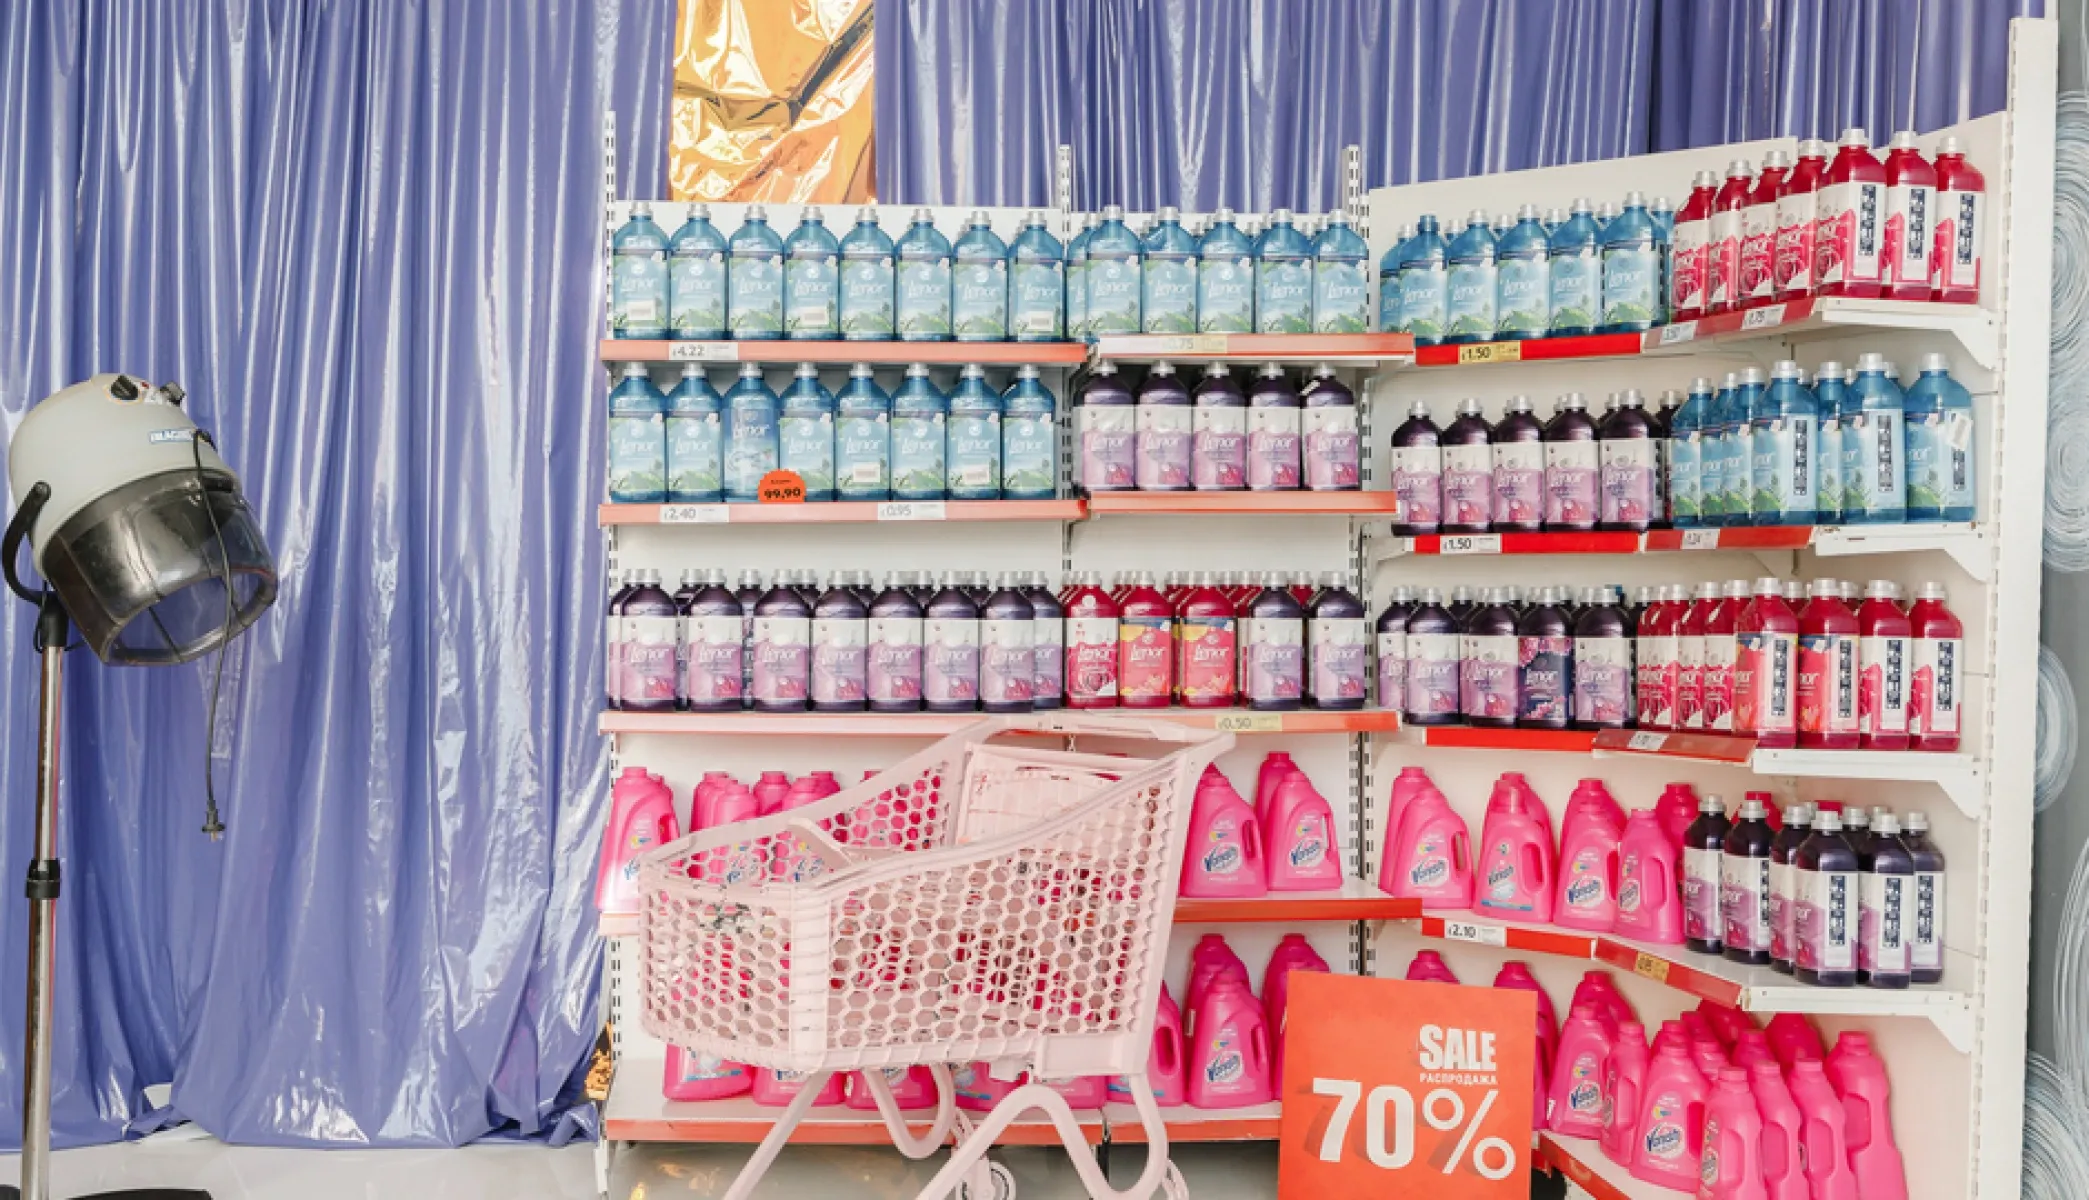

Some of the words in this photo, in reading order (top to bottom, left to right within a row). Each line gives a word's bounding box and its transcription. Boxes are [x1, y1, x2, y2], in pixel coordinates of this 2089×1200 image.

[1420, 1024, 1496, 1071] SALE
[1420, 1073, 1497, 1085] РАСПРОДАЖА
[1312, 1077, 1516, 1181] 70%
